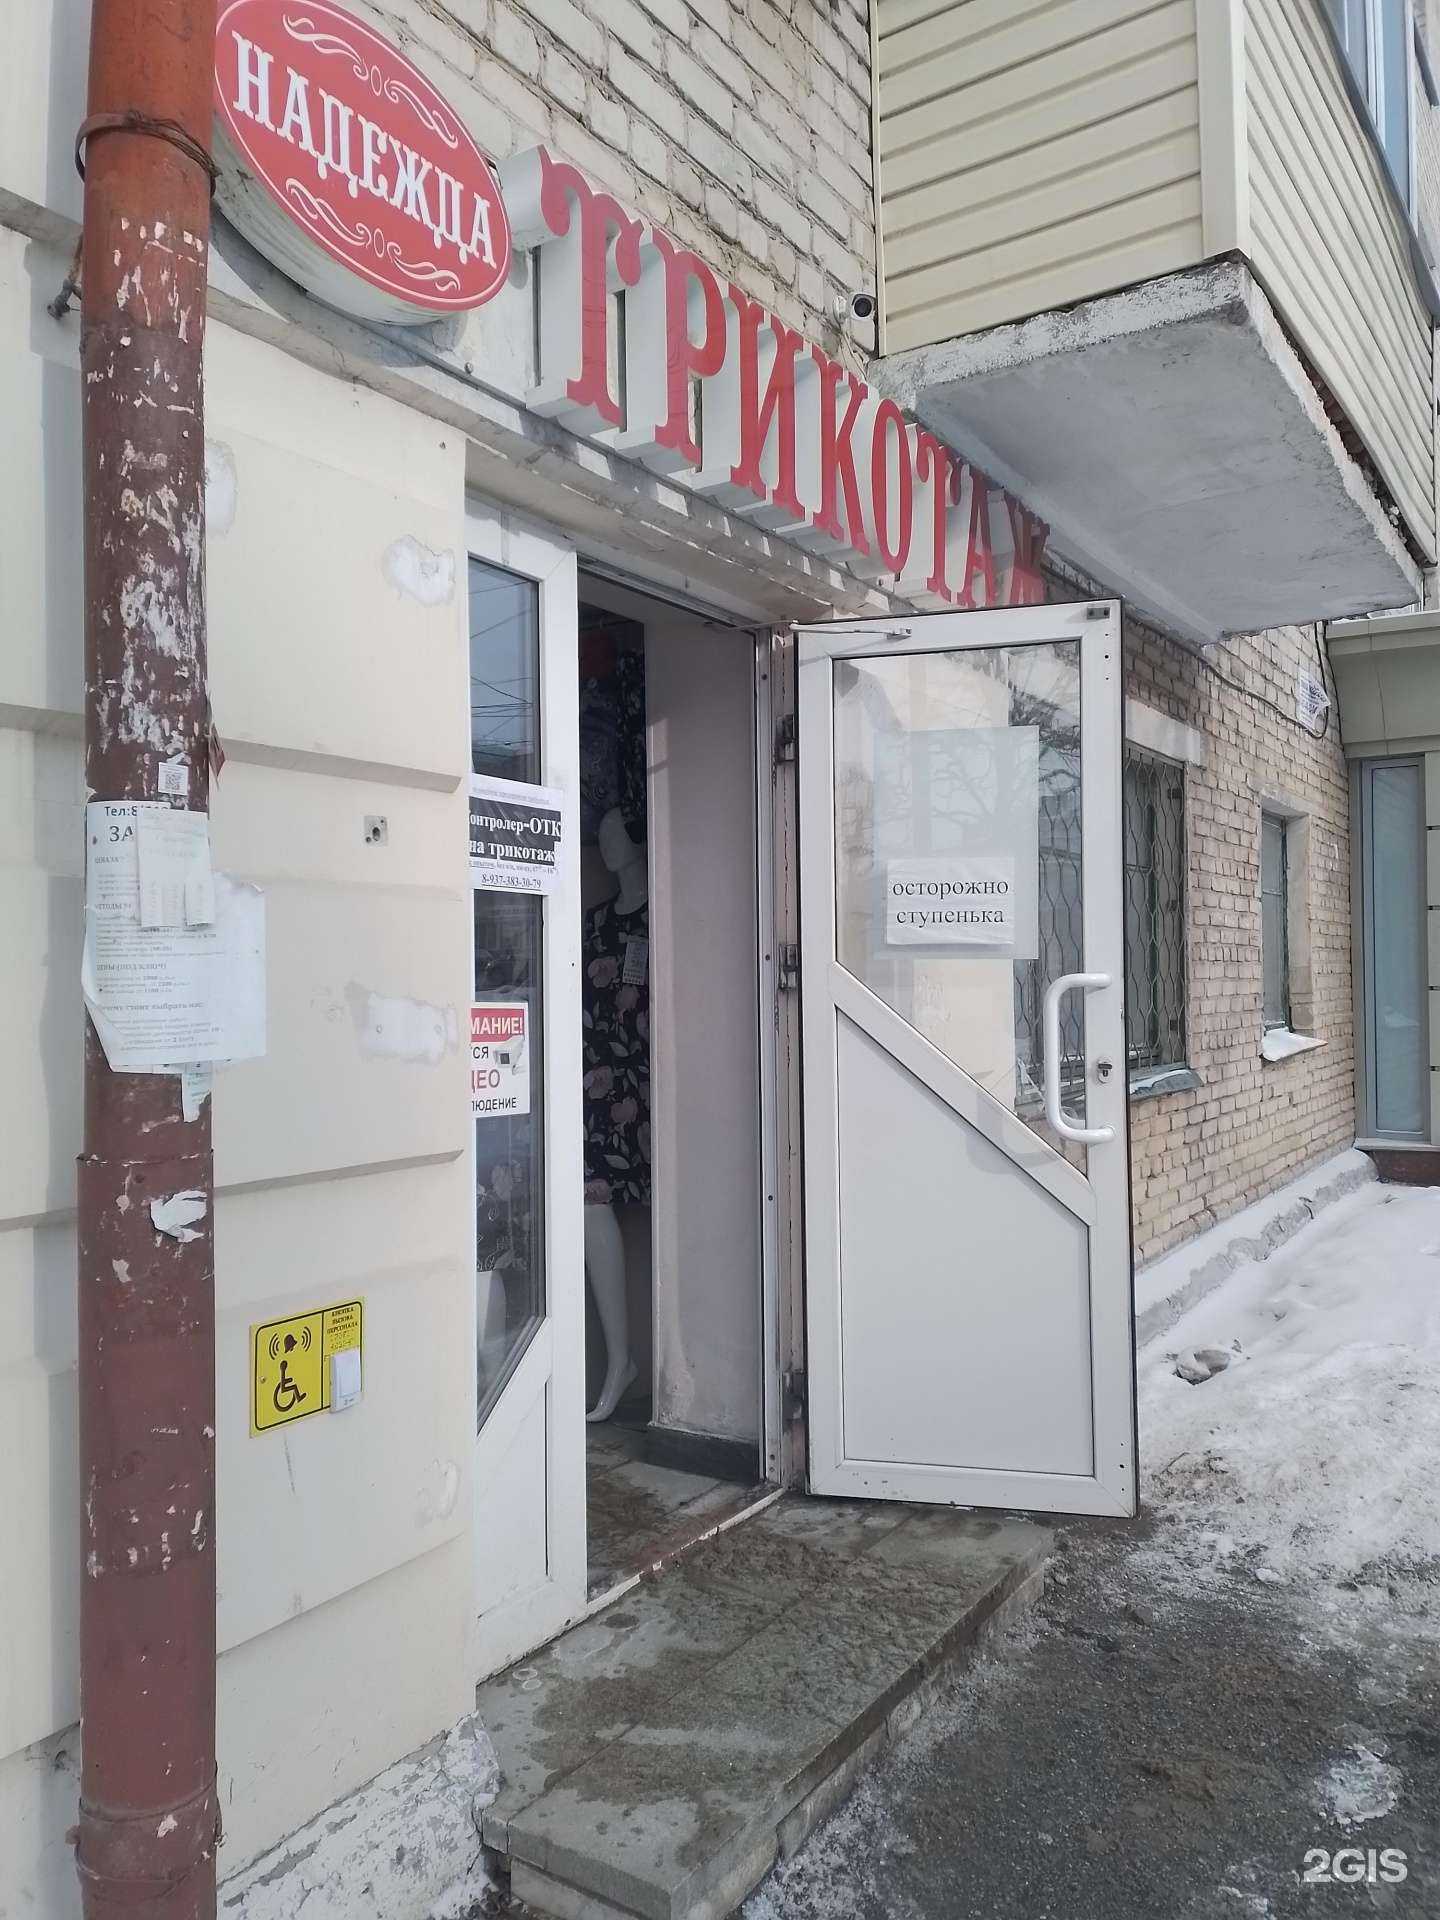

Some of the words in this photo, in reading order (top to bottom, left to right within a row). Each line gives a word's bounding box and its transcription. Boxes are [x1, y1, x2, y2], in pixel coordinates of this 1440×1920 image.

[232, 31, 497, 268] НАДЕЖДА
[541, 144, 1050, 608] ТРИКОТАЖ
[468, 814, 561, 837] онтролер-ОТК
[488, 843, 556, 862] трикотаж
[481, 873, 542, 889] 8-937-383-30-79
[892, 880, 1009, 899] осторожно
[896, 909, 1004, 928] ступенька
[471, 1046, 489, 1060] СЯ
